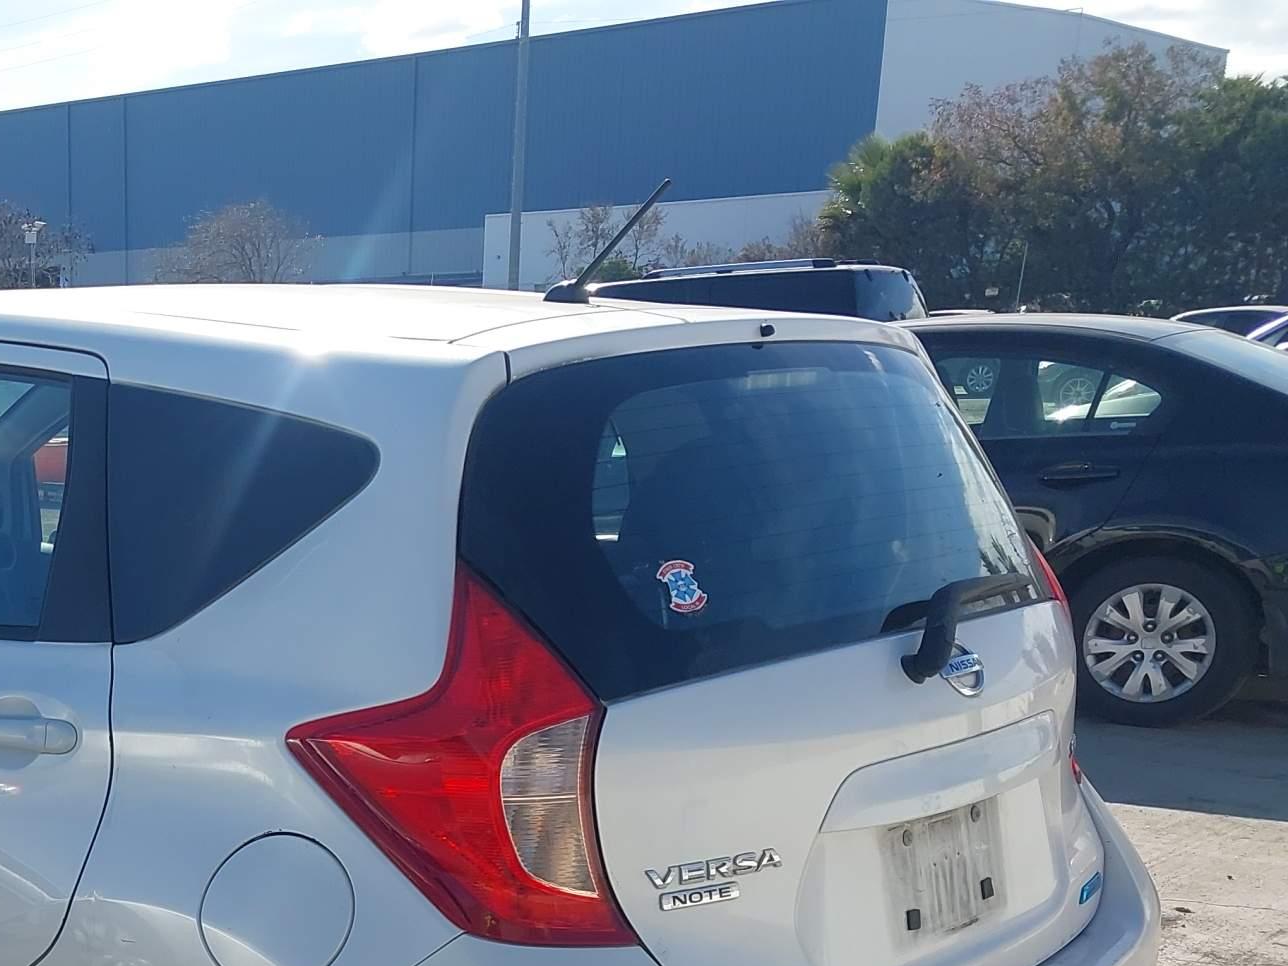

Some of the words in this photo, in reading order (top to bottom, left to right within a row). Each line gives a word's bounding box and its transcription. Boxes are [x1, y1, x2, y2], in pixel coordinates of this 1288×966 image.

[949, 657, 981, 673] NISSA
[644, 847, 783, 889] VERSA
[672, 886, 732, 906] NOTE
